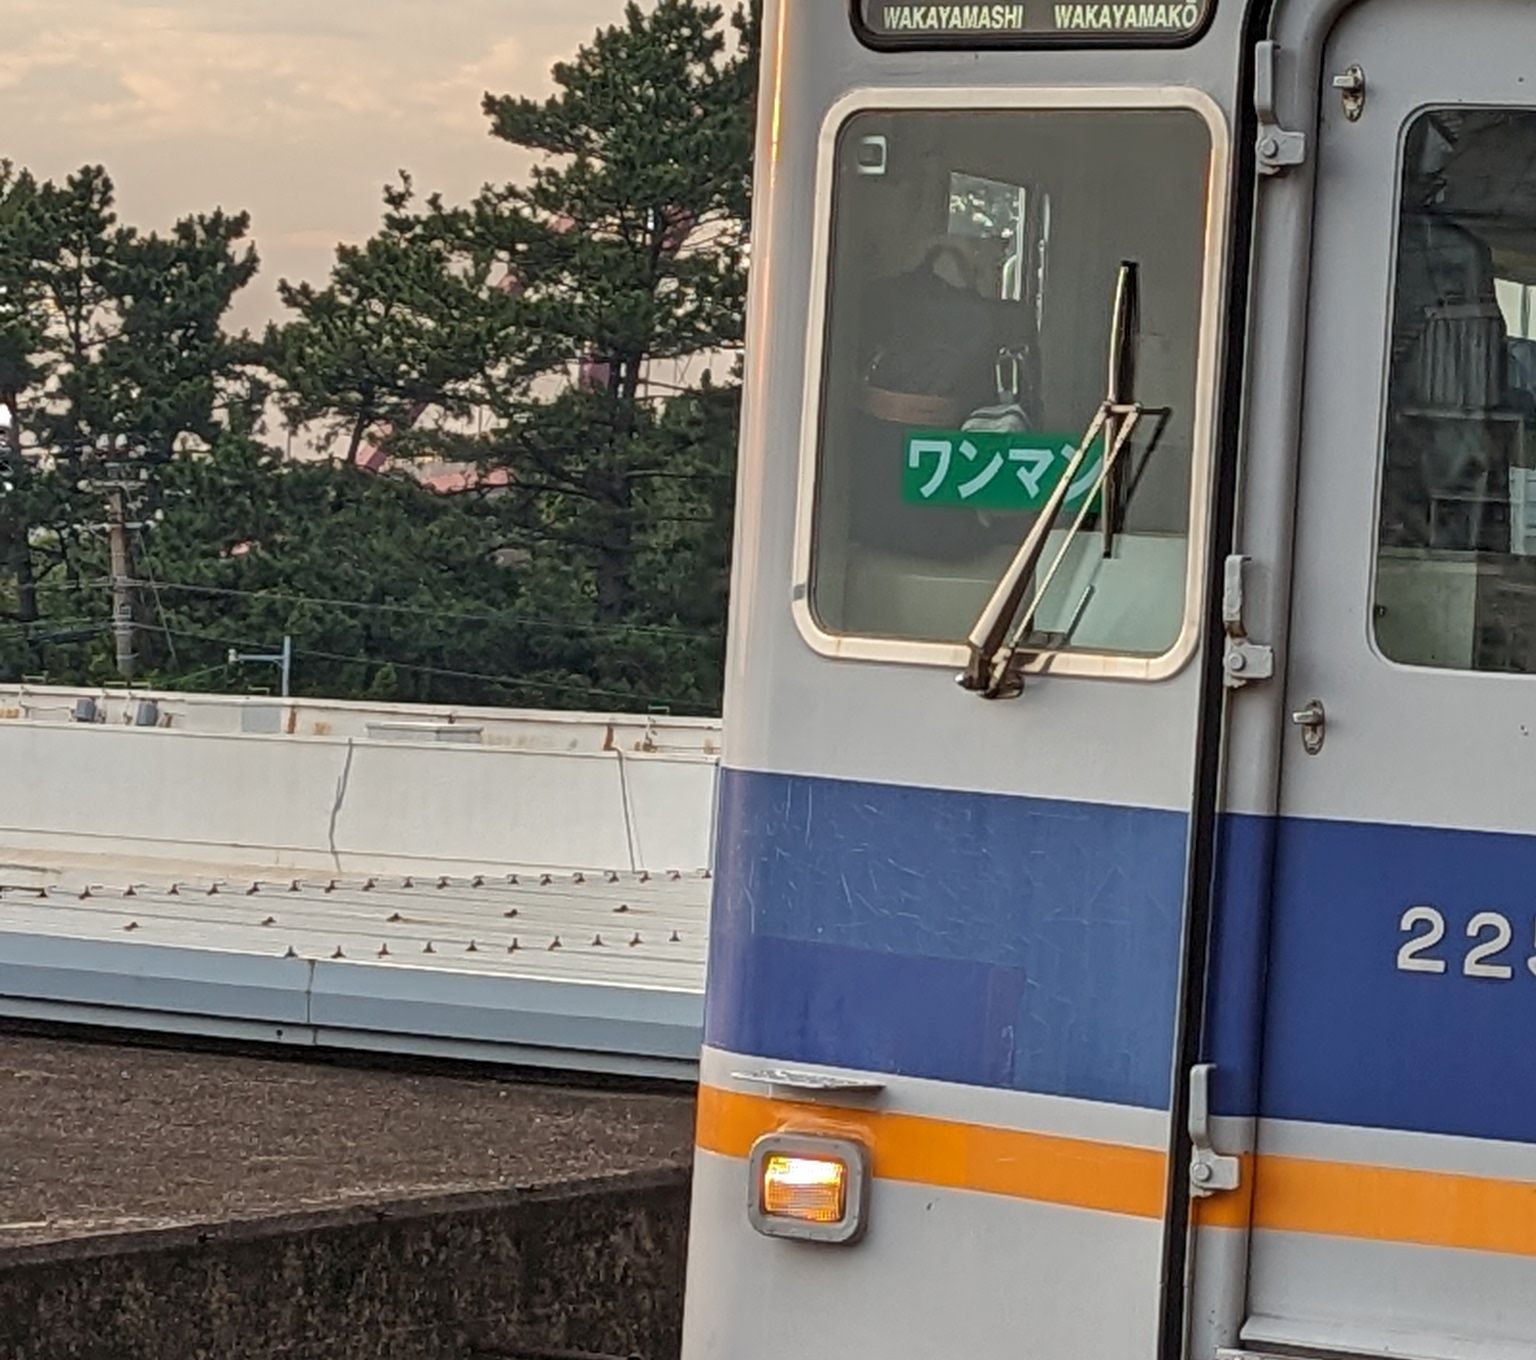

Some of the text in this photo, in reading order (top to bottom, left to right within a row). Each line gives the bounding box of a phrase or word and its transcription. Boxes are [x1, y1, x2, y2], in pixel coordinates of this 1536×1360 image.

[883, 4, 1024, 30] WAKAYAMASHI
[909, 439, 1106, 502] ワンマン
